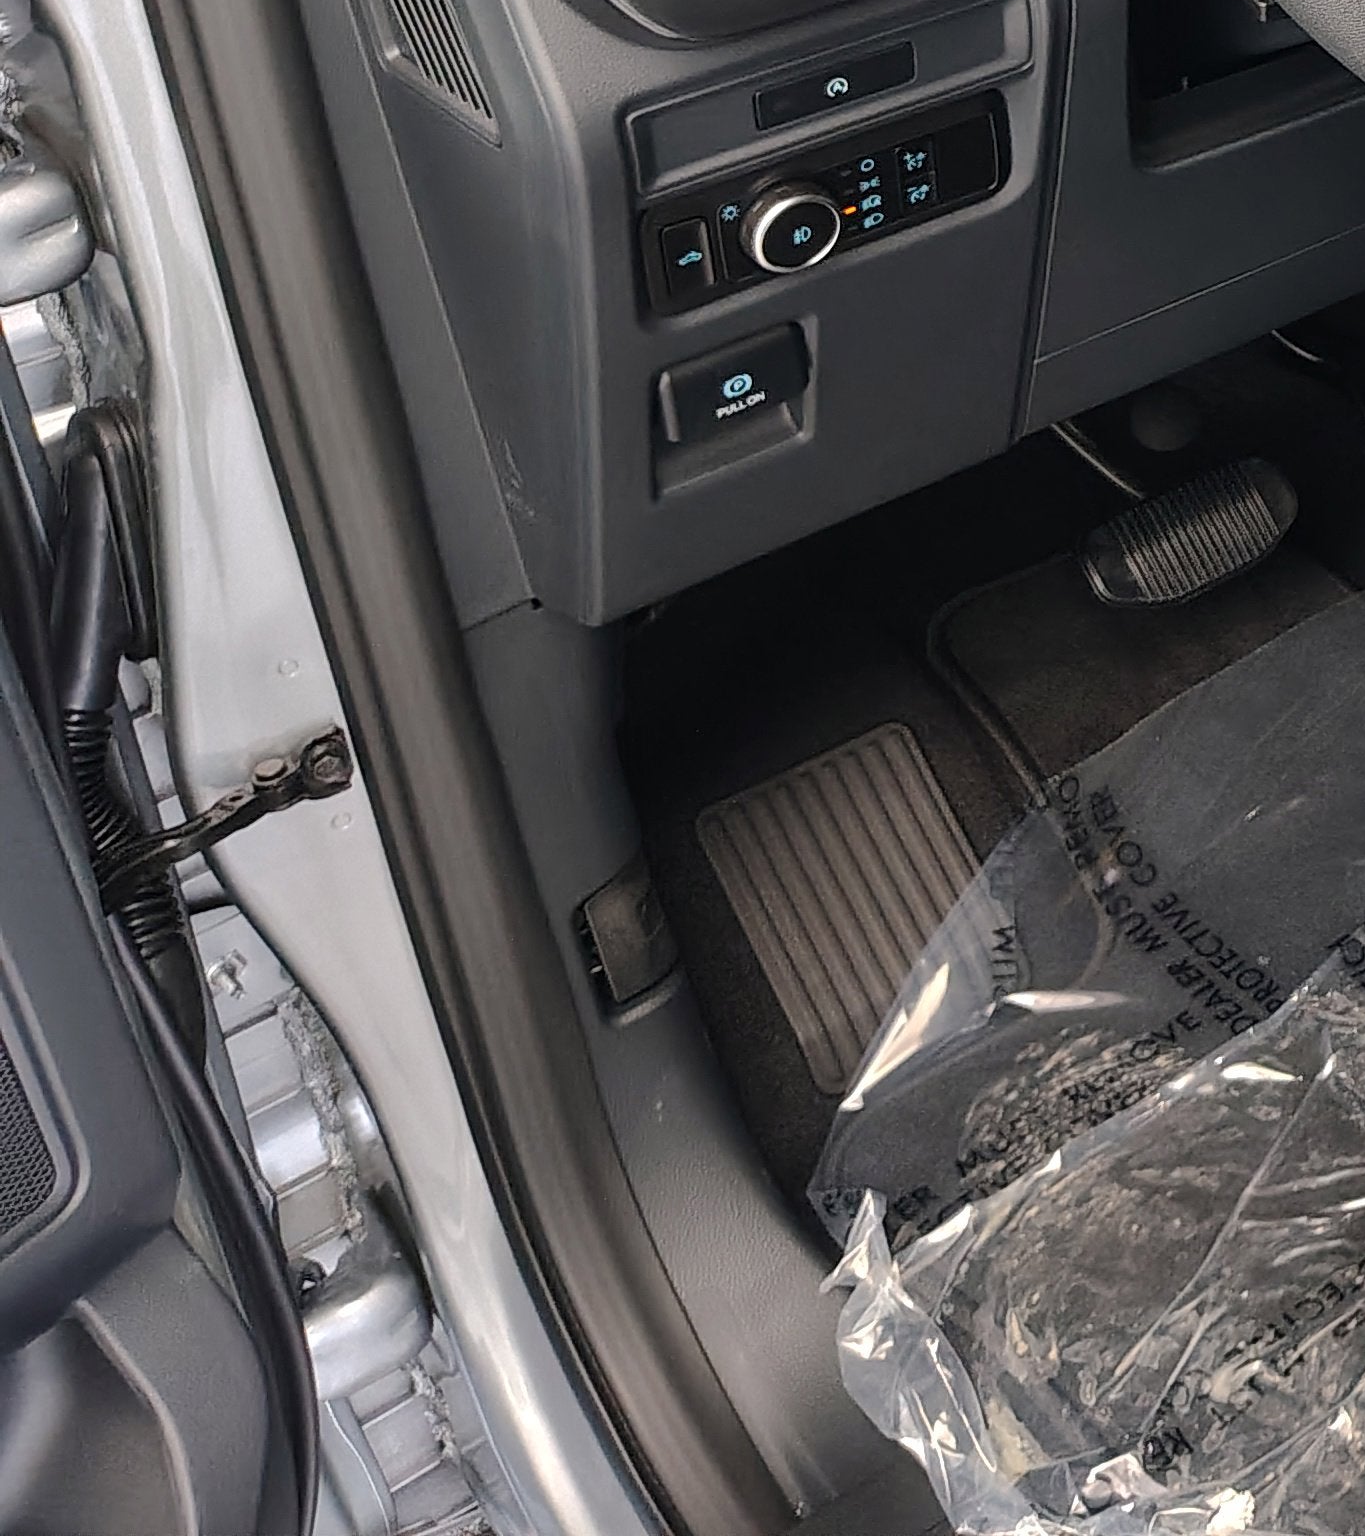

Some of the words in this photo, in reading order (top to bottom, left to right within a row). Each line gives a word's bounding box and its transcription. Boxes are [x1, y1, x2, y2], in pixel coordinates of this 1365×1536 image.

[715, 400, 748, 419] PULL
[746, 391, 766, 407] ON
[1058, 778, 1098, 871] REMO
[1086, 785, 1154, 890] COVER
[1092, 882, 1169, 954] MUST
[1152, 890, 1290, 1016] PROTECTIVE
[1168, 959, 1257, 1035] DEALER
